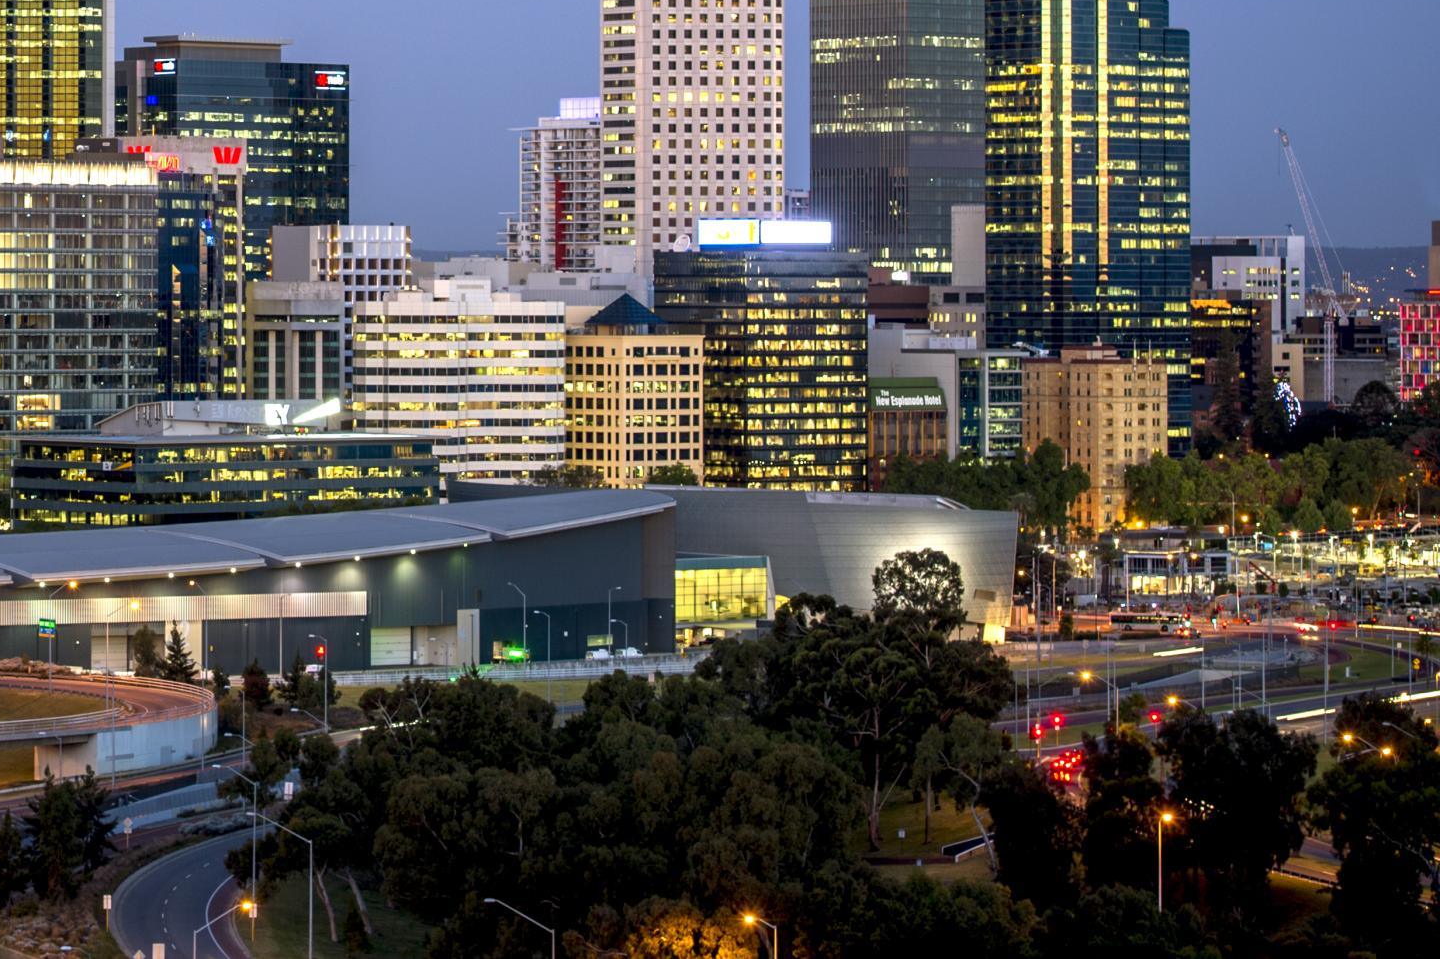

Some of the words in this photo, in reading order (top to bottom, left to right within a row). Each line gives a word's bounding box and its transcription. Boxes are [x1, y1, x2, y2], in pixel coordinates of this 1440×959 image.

[875, 396, 890, 406] New
[891, 395, 924, 408] Esplanade
[924, 395, 942, 406] Hotel
[264, 403, 290, 425] EY
[102, 462, 113, 471] EY
